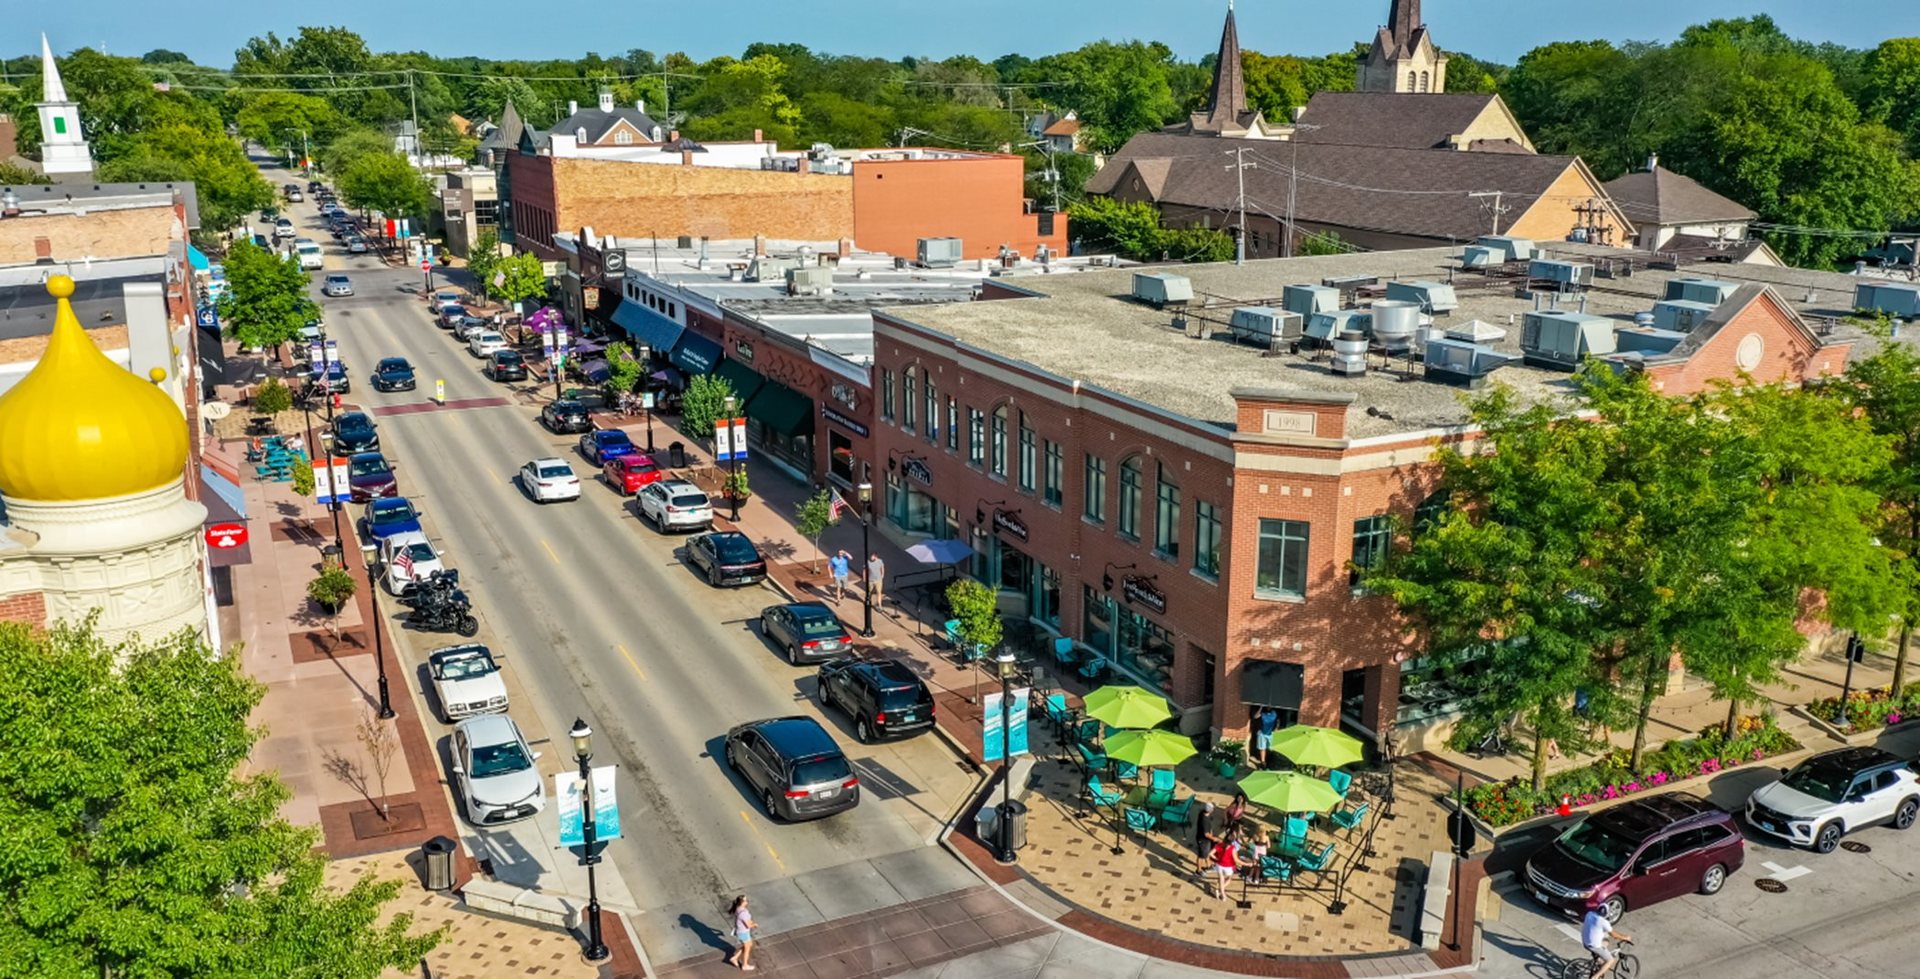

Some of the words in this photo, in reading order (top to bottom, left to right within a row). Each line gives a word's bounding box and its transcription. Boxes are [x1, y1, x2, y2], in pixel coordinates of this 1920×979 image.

[1279, 416, 1300, 429] 1998
[317, 477, 326, 486] L
[337, 475, 347, 484] L
